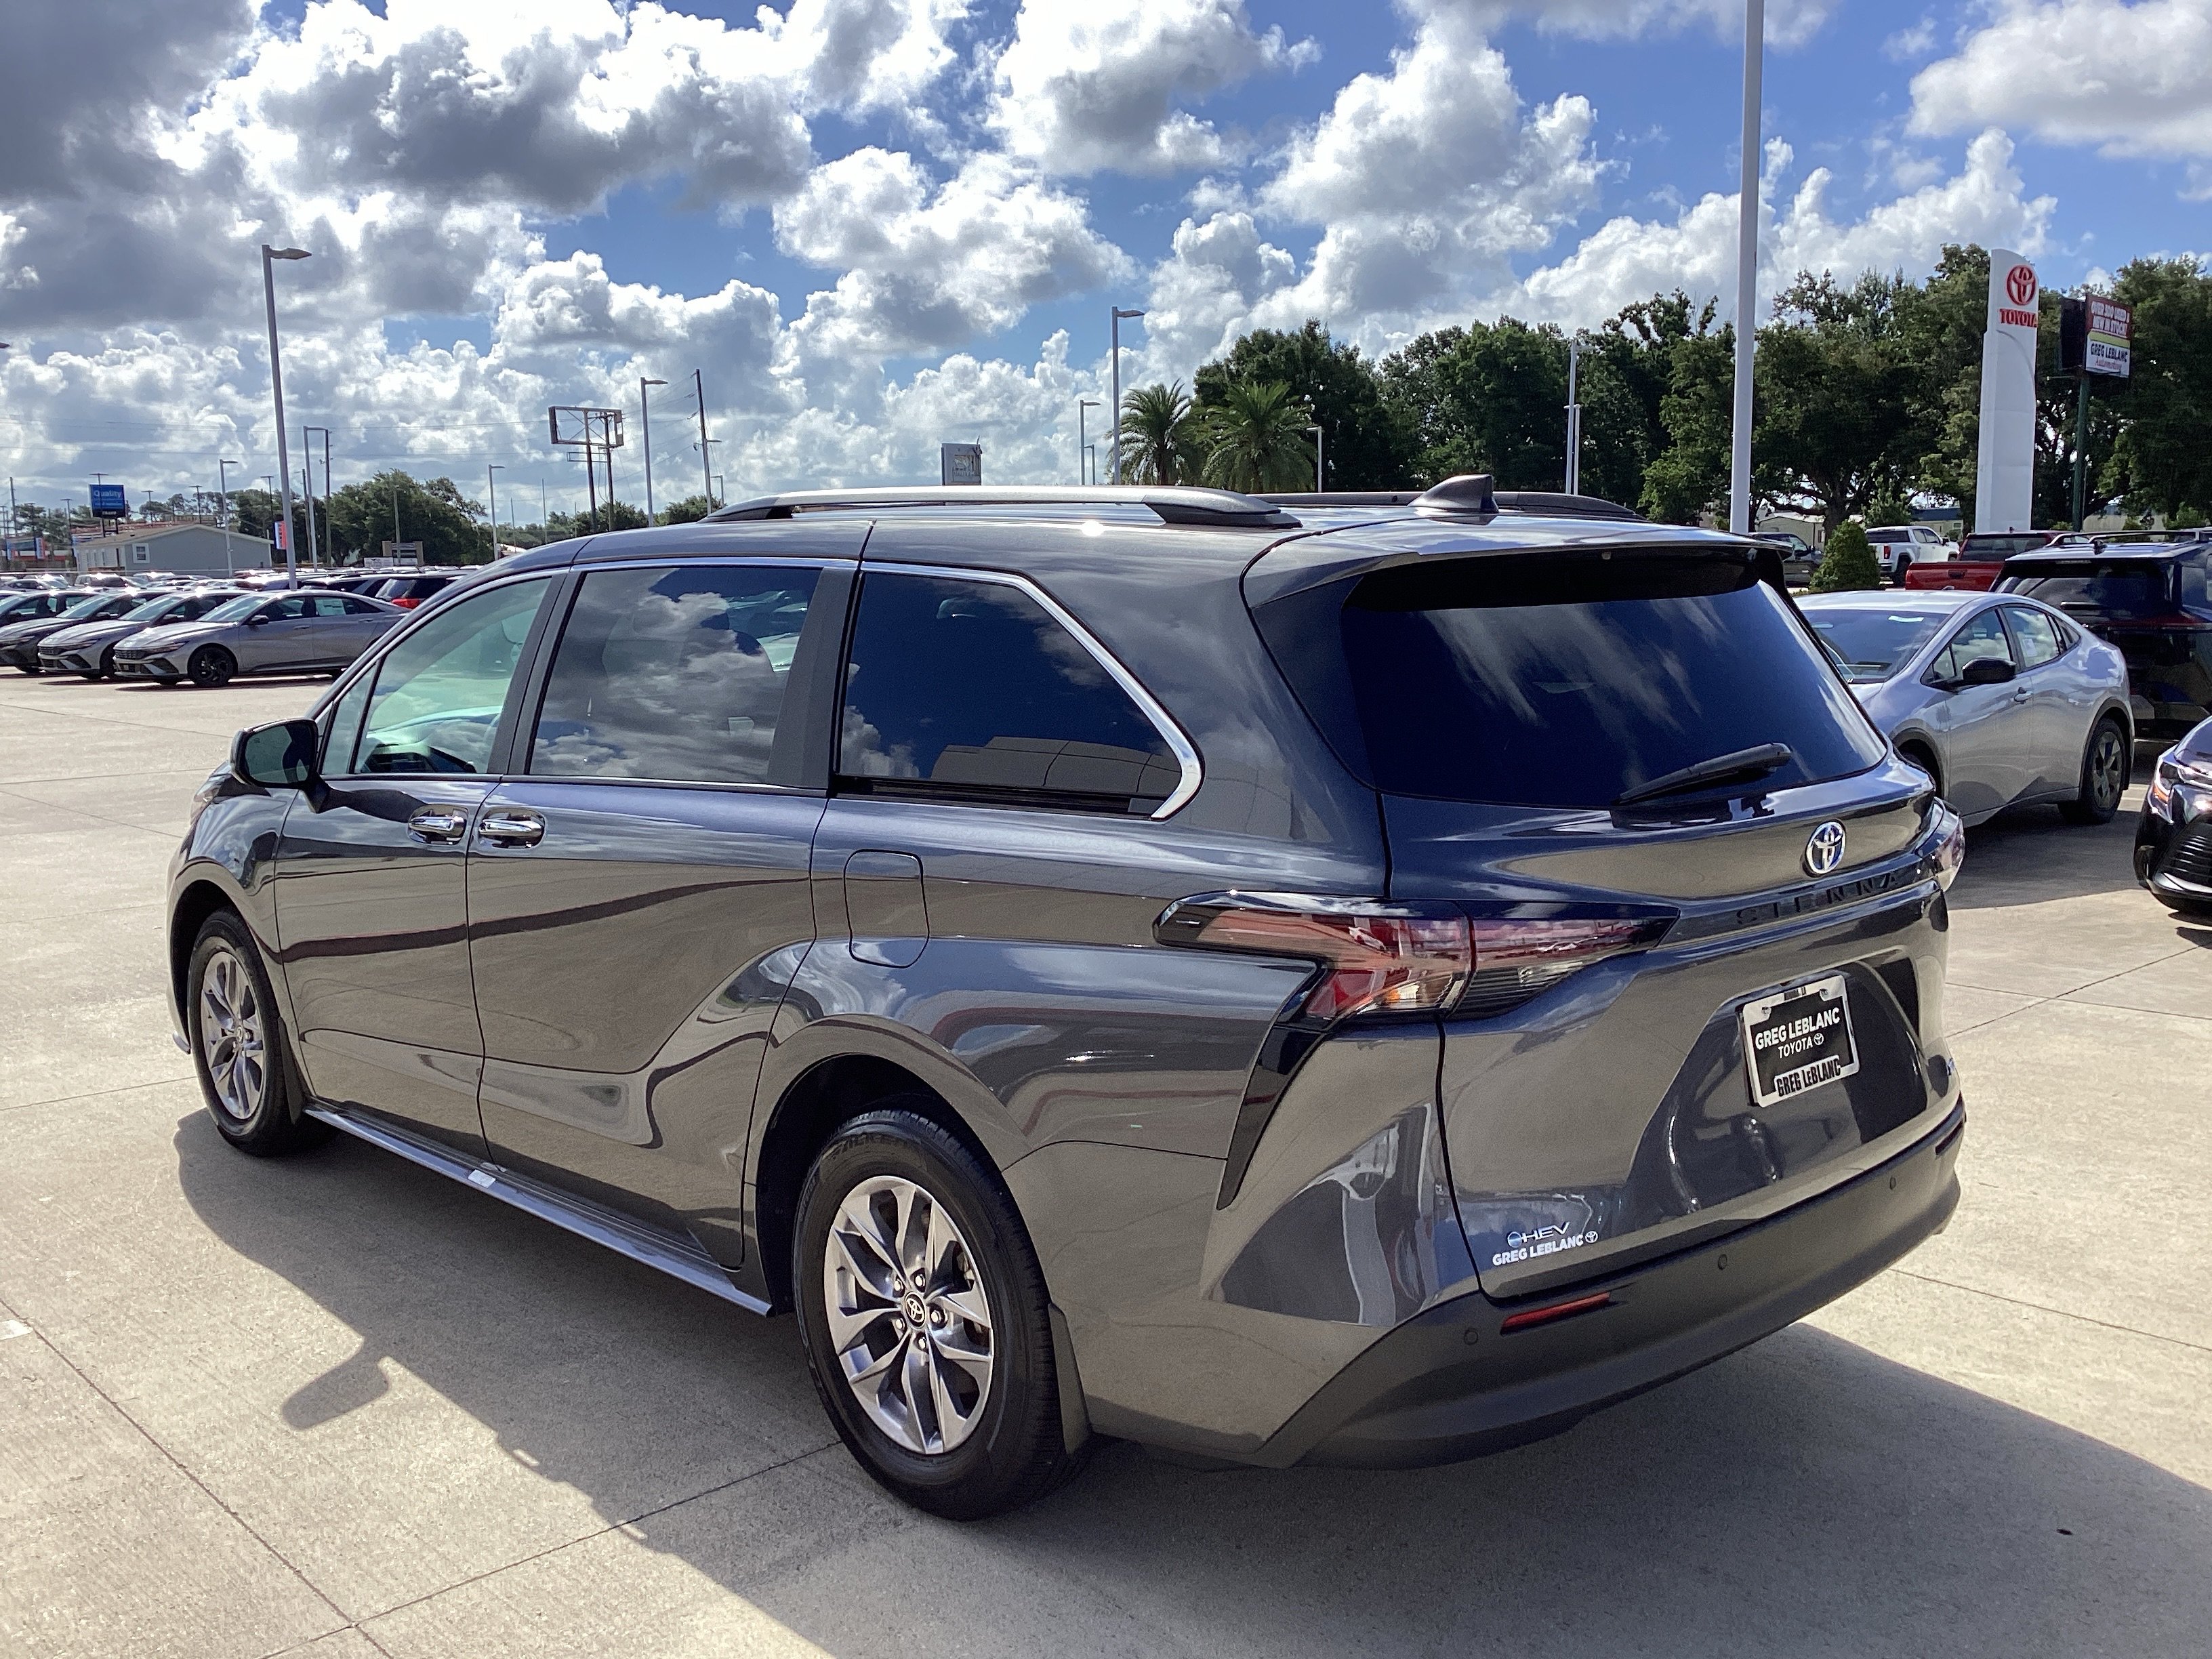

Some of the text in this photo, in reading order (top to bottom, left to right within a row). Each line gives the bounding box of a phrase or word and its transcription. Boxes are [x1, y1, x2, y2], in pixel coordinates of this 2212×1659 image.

[1999, 308, 2038, 327] TOYOTA
[2091, 342, 2127, 363] GREG LEBLANC
[94, 490, 121, 498] Quality
[1755, 1007, 1841, 1050] GREG LEBLANC
[1778, 1036, 1814, 1059] TOYOTA
[1776, 1072, 1802, 1097] GREG
[1492, 1234, 1584, 1267] GREG LEBLANC
